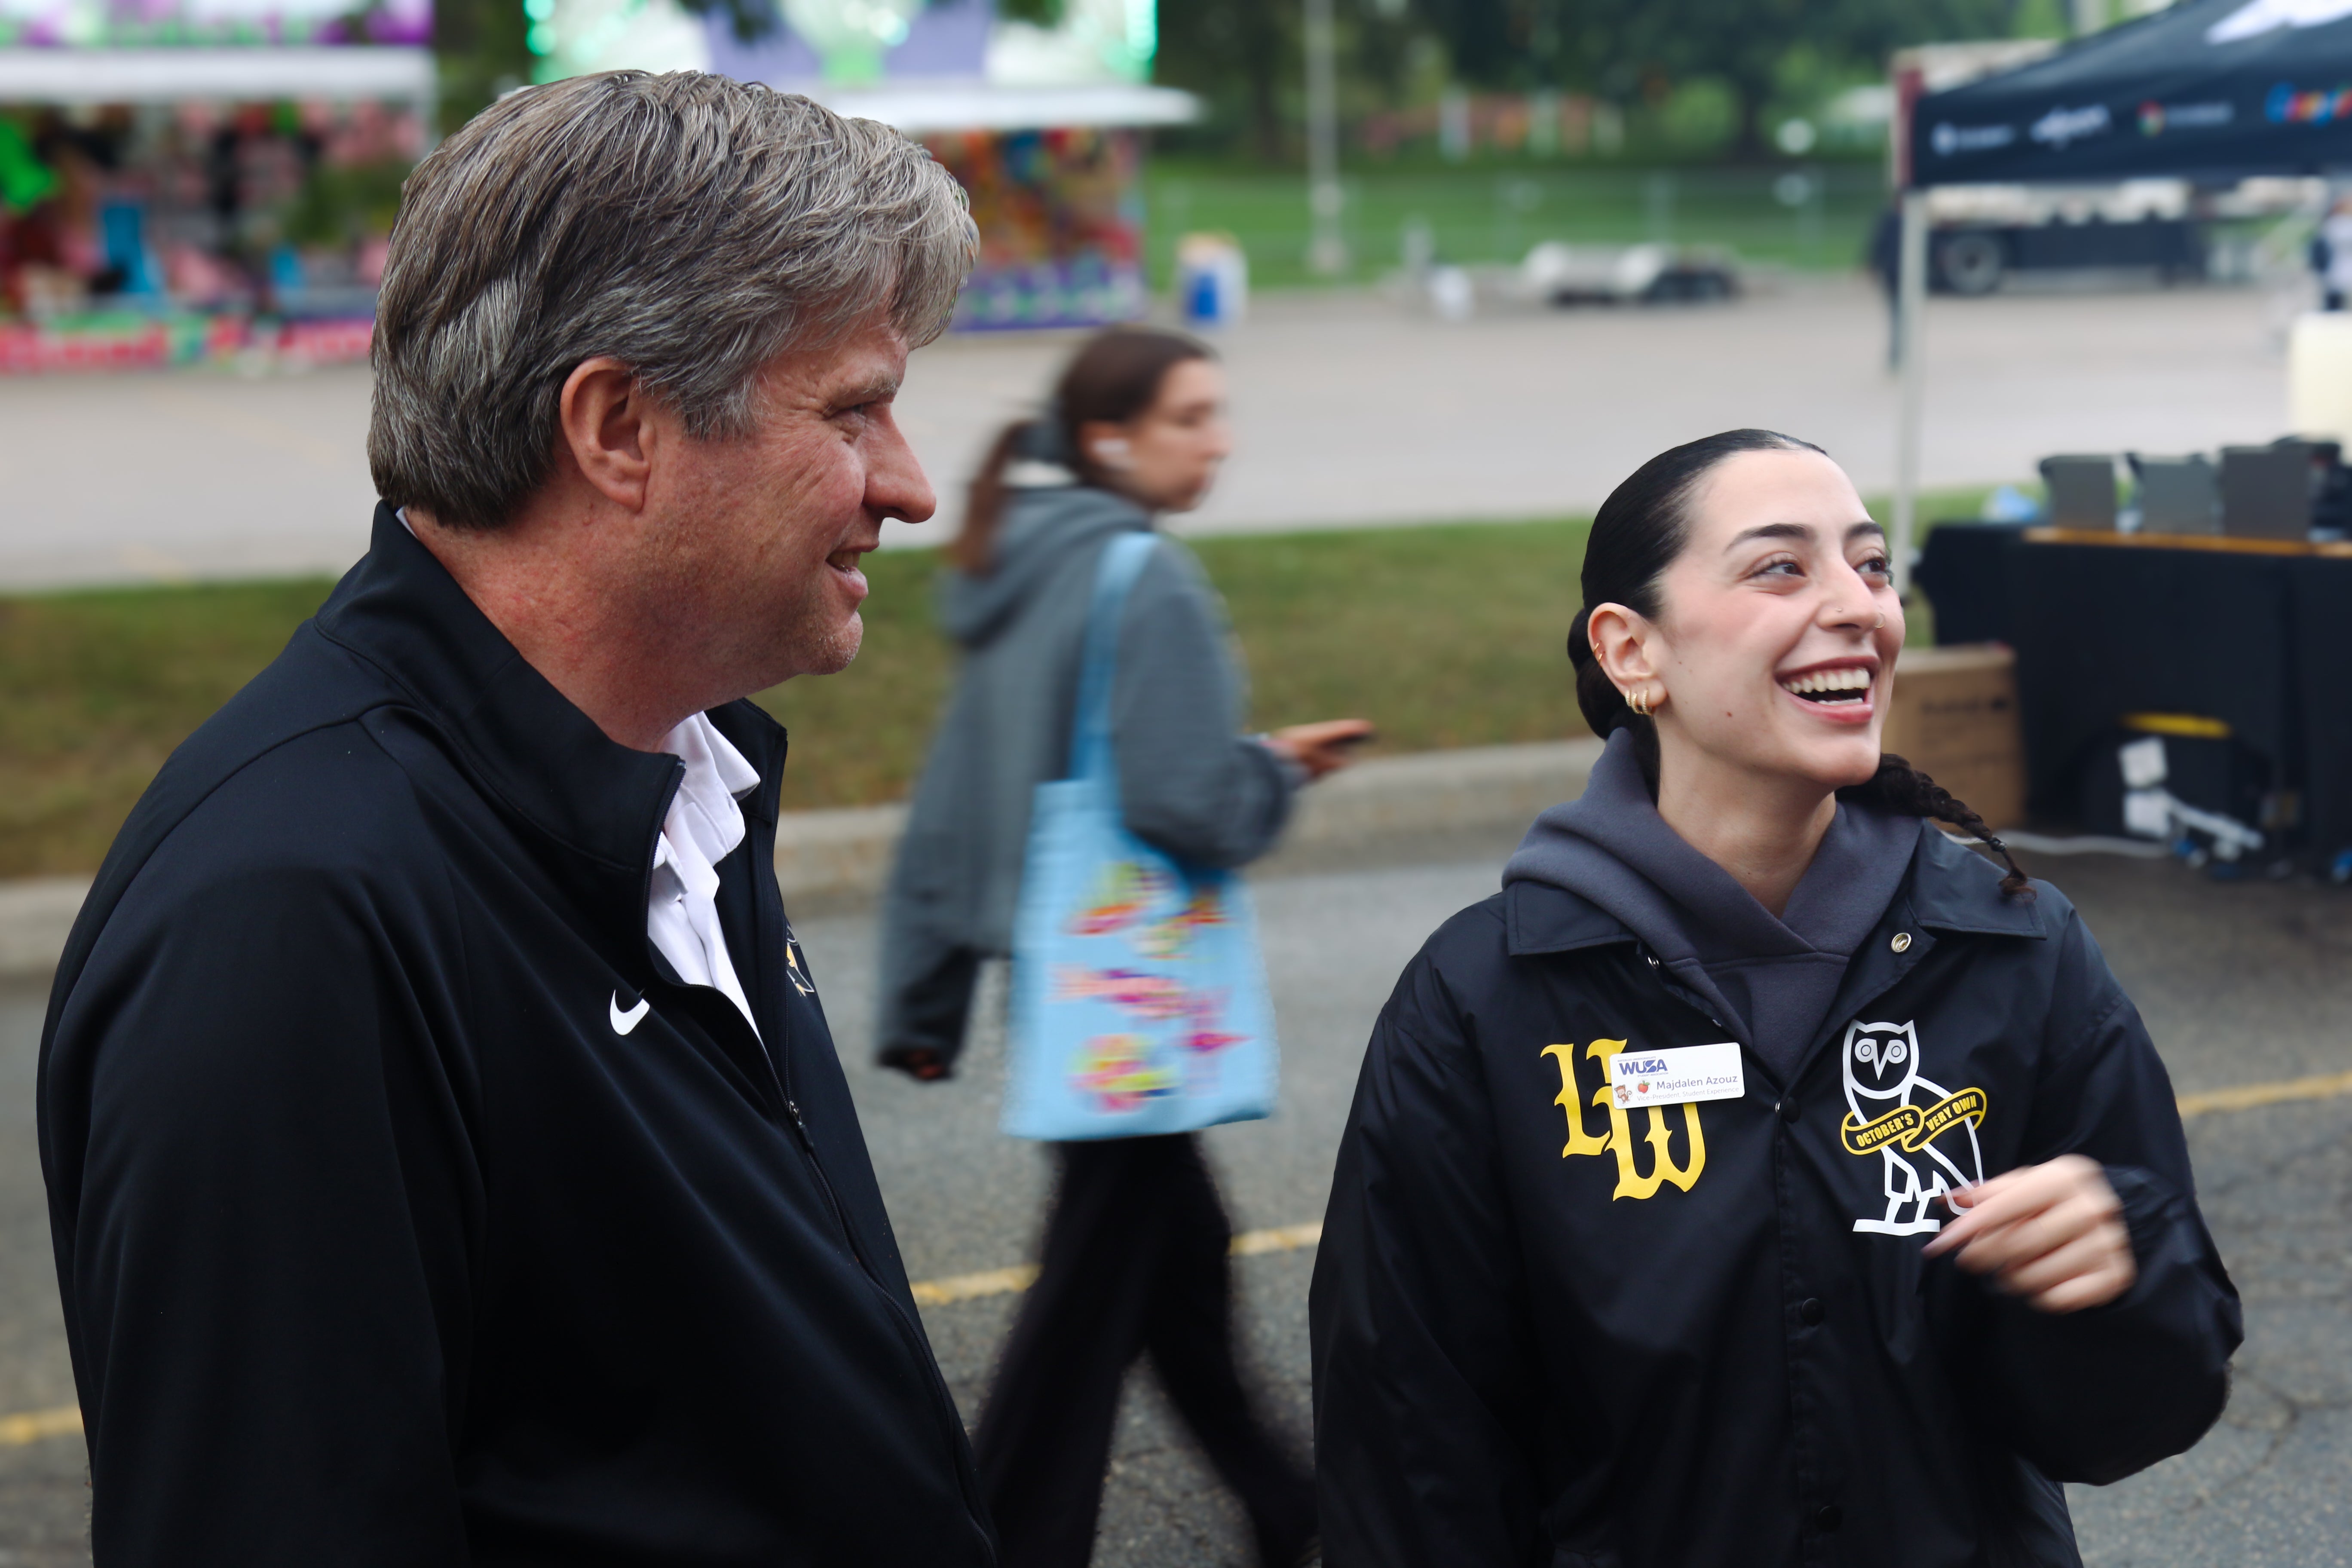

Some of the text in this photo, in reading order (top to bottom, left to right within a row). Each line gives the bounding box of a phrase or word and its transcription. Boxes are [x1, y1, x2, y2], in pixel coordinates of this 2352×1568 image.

[1619, 1059, 1668, 1075] WUSA
[1657, 1076, 1738, 1090] Majdalen Azouz
[1856, 1095, 1977, 1147] OCTOBER'S VERY OWN
